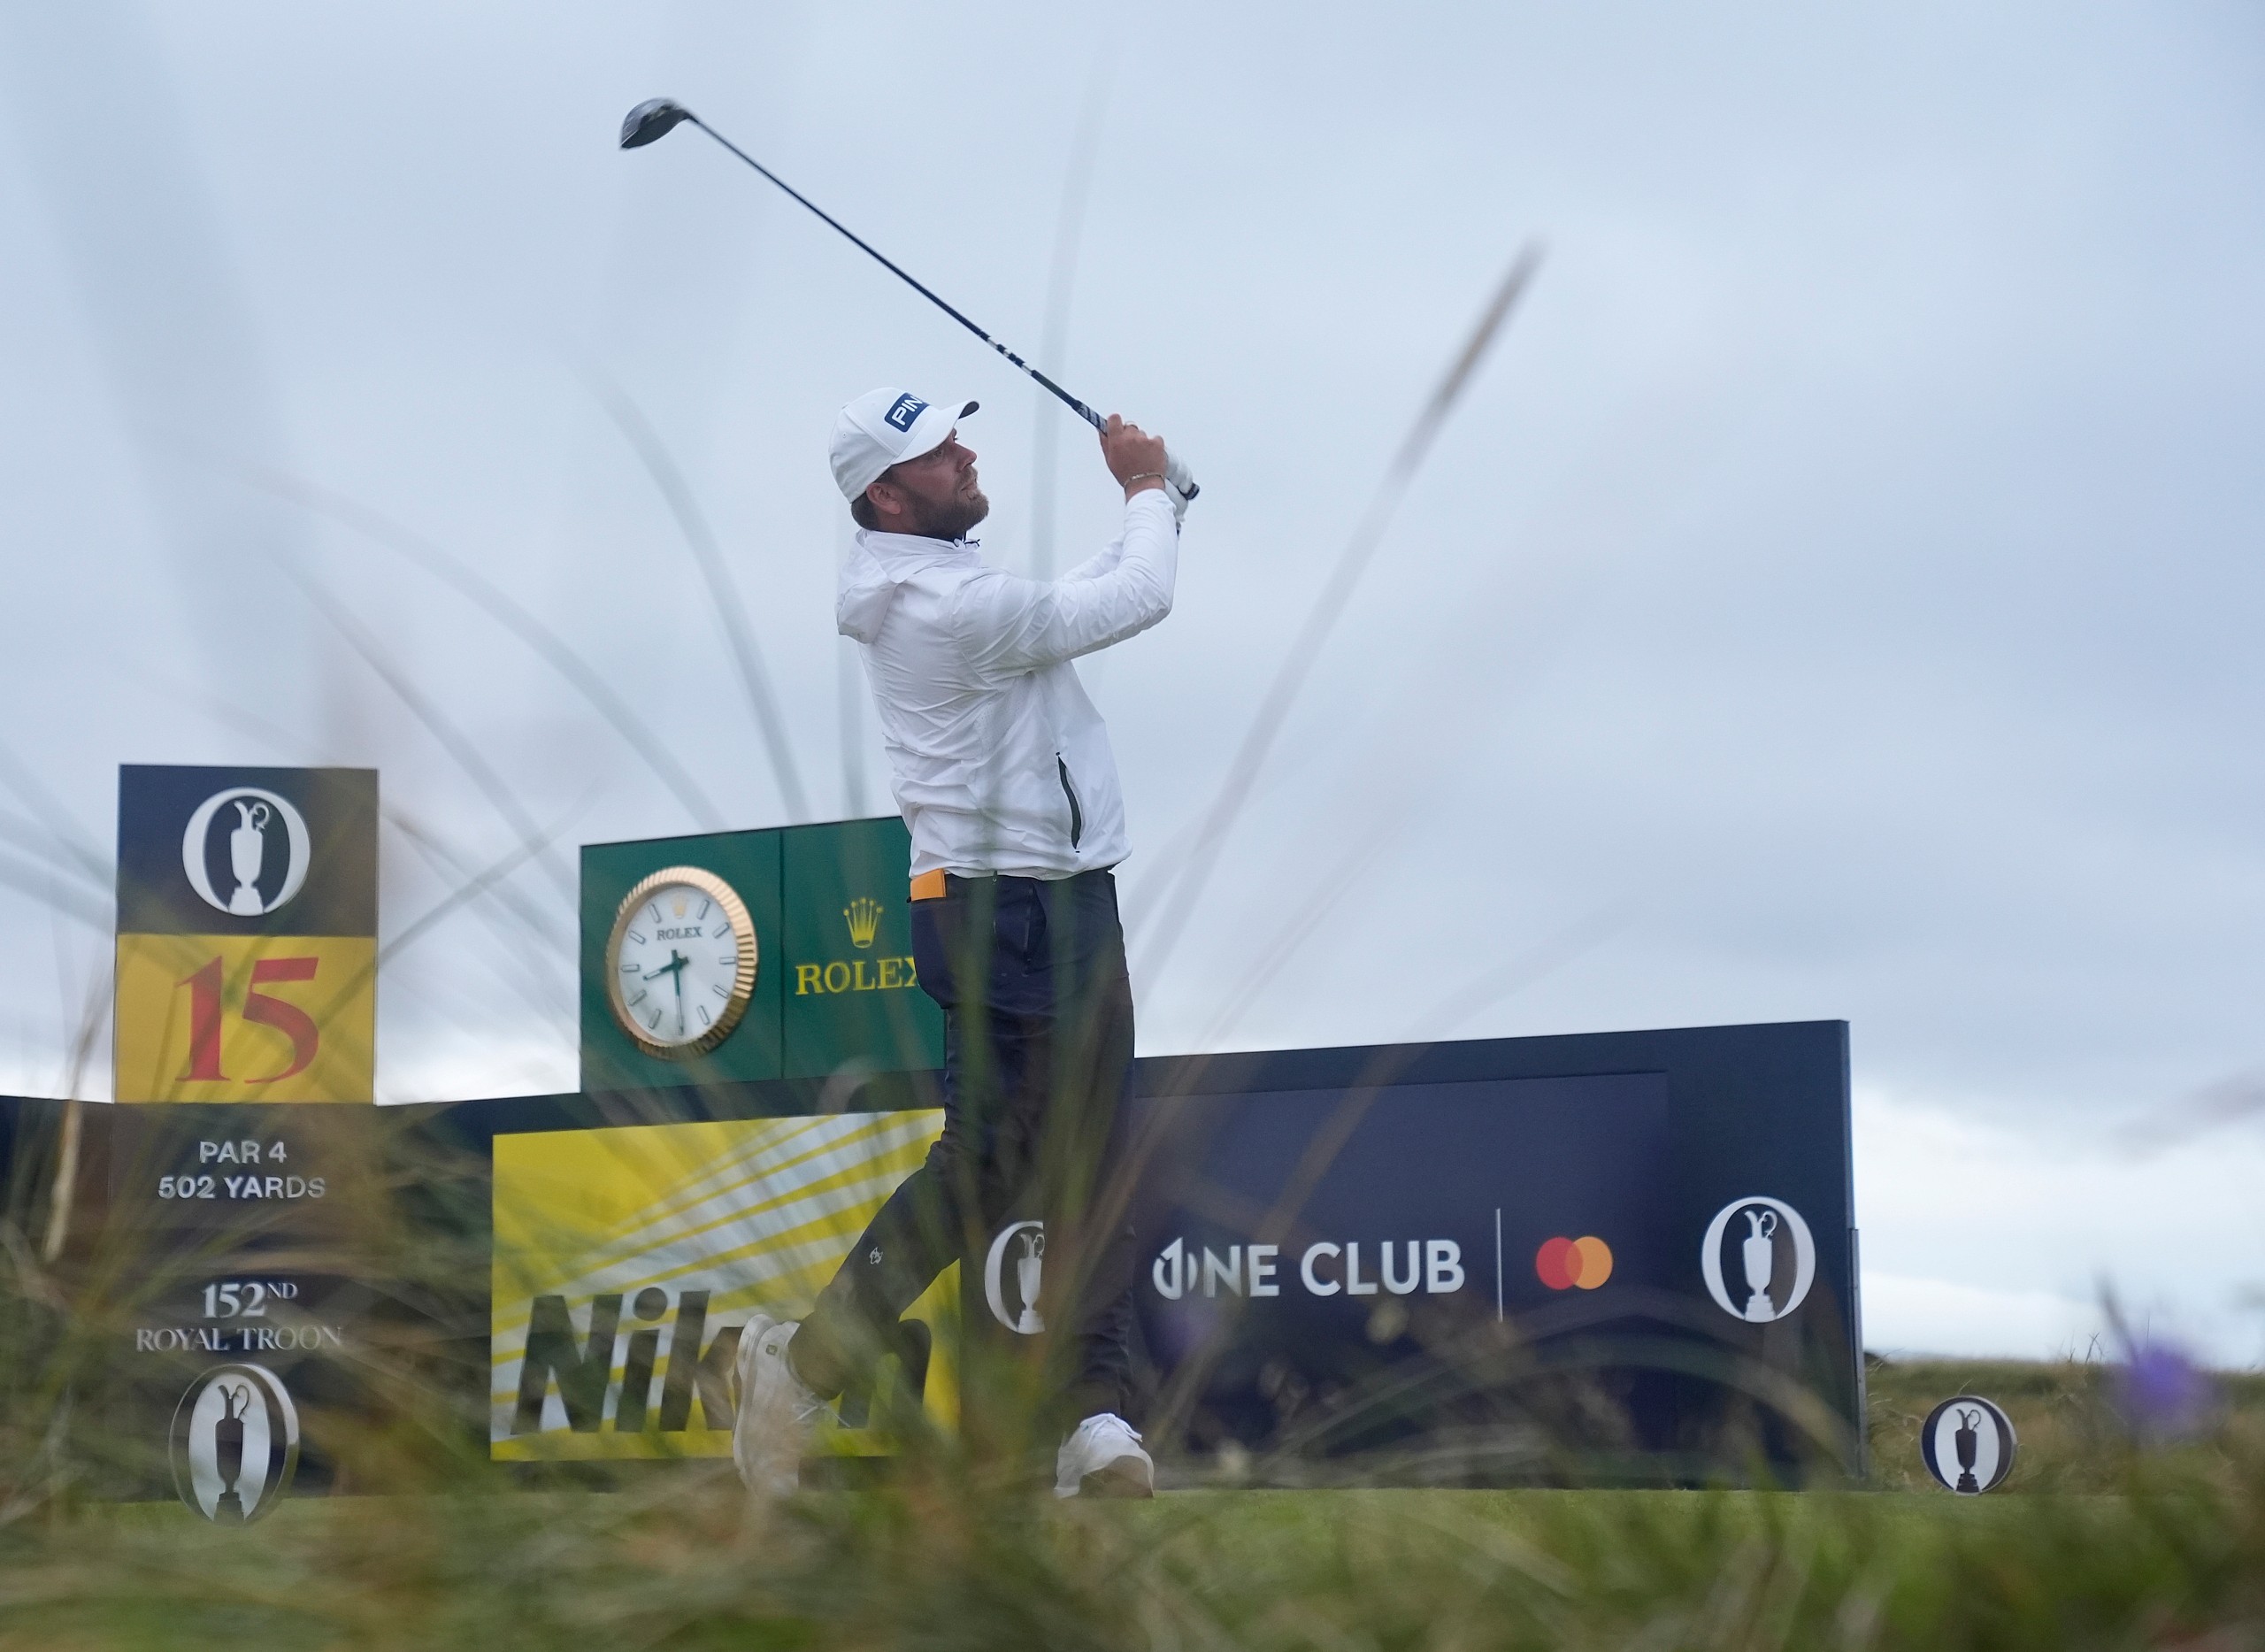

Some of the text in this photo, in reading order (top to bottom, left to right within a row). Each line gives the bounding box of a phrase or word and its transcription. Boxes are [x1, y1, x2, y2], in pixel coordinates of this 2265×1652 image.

[656, 926, 703, 941] ROLEX
[174, 956, 319, 1084] 15
[199, 1140, 287, 1164] PAR 4
[158, 1176, 326, 1199] 502 YARDS
[1300, 1240, 1465, 1297] CLUB
[136, 1326, 343, 1352] ROYAL TROON
